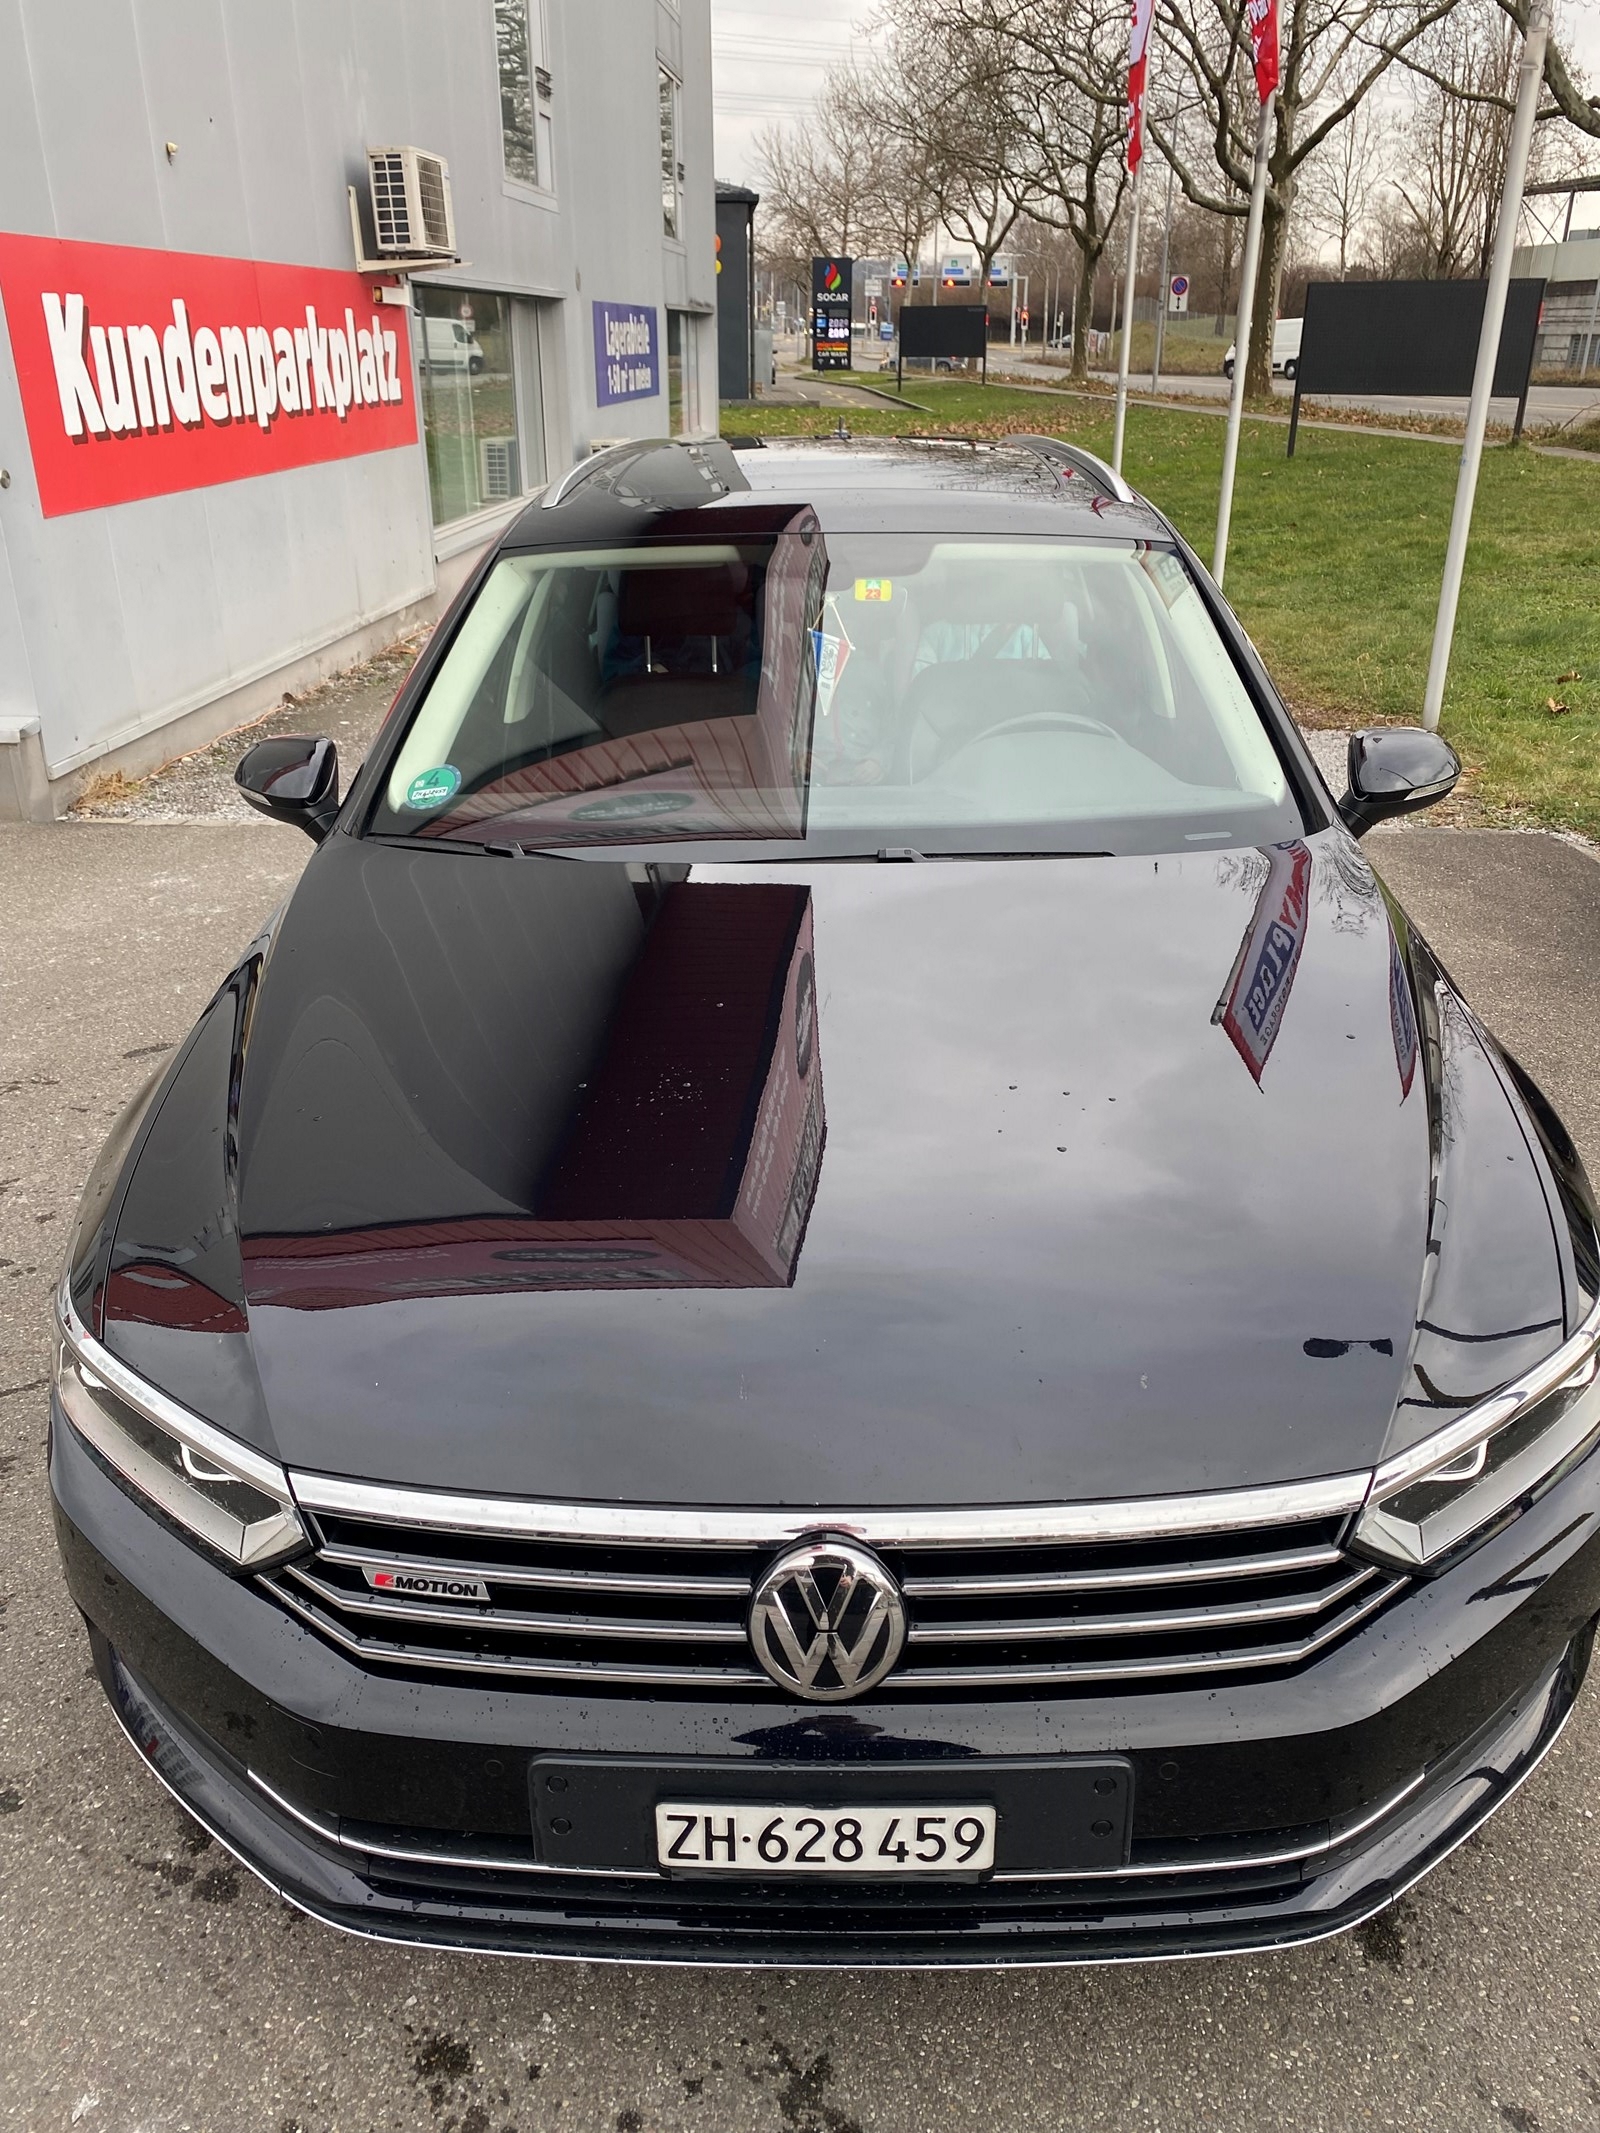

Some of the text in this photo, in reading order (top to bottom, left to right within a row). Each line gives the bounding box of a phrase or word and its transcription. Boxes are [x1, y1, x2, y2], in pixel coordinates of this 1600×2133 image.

[816, 292, 849, 302] SOCAR
[41, 292, 402, 438] Kundenparkplatz
[865, 589, 881, 600] 23
[426, 770, 440, 787] 4
